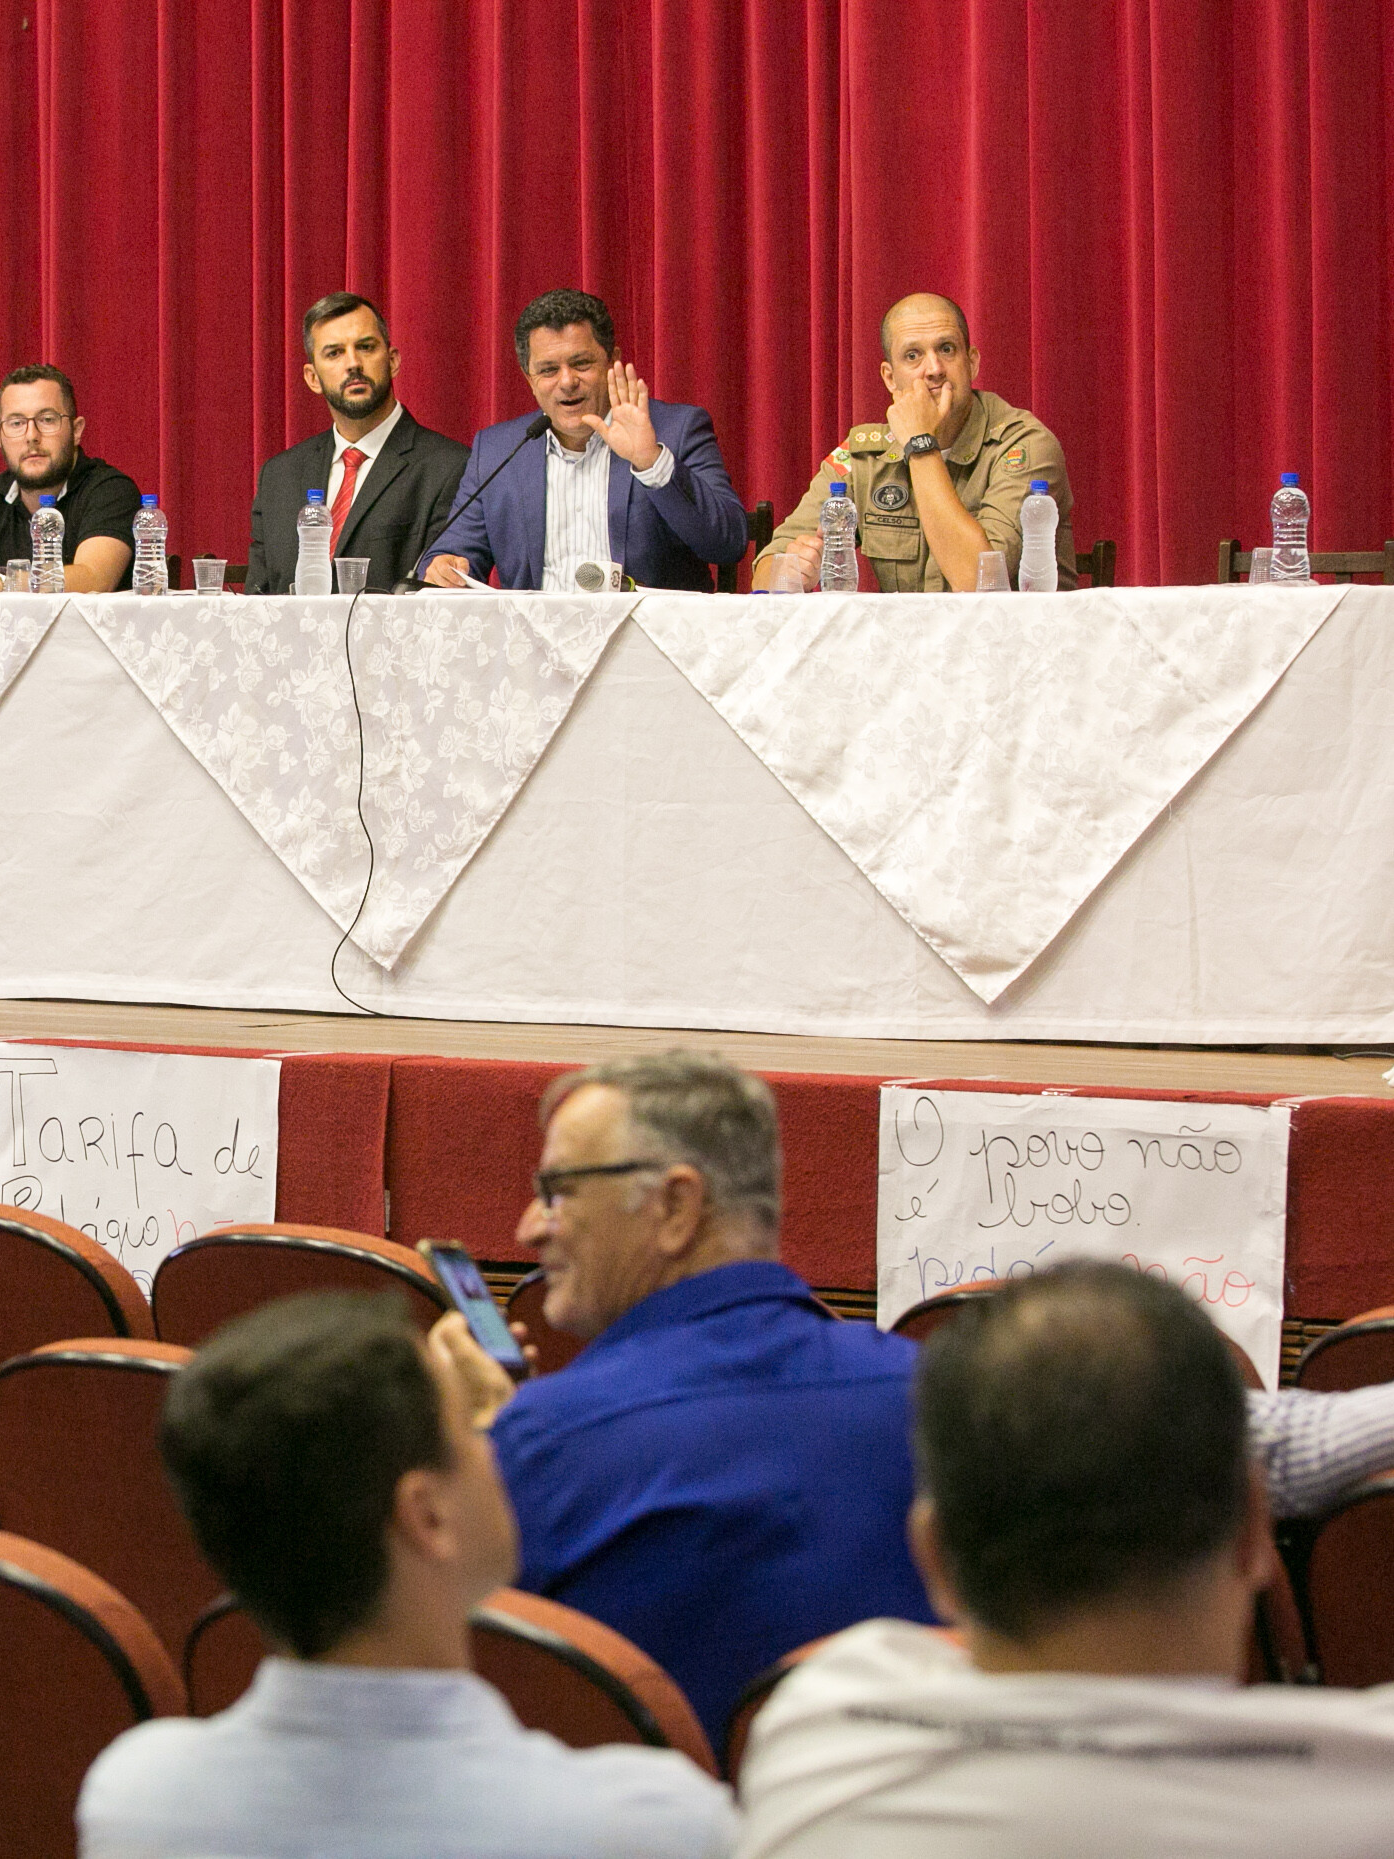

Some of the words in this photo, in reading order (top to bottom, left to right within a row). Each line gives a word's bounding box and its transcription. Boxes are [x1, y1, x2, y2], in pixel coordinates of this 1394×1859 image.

[877, 516, 902, 525] CELSO
[213, 1117, 263, 1179] de
[894, 1096, 944, 1167] O
[969, 1129, 1106, 1204] povo
[1126, 1122, 1243, 1174] não
[894, 1178, 940, 1221] é
